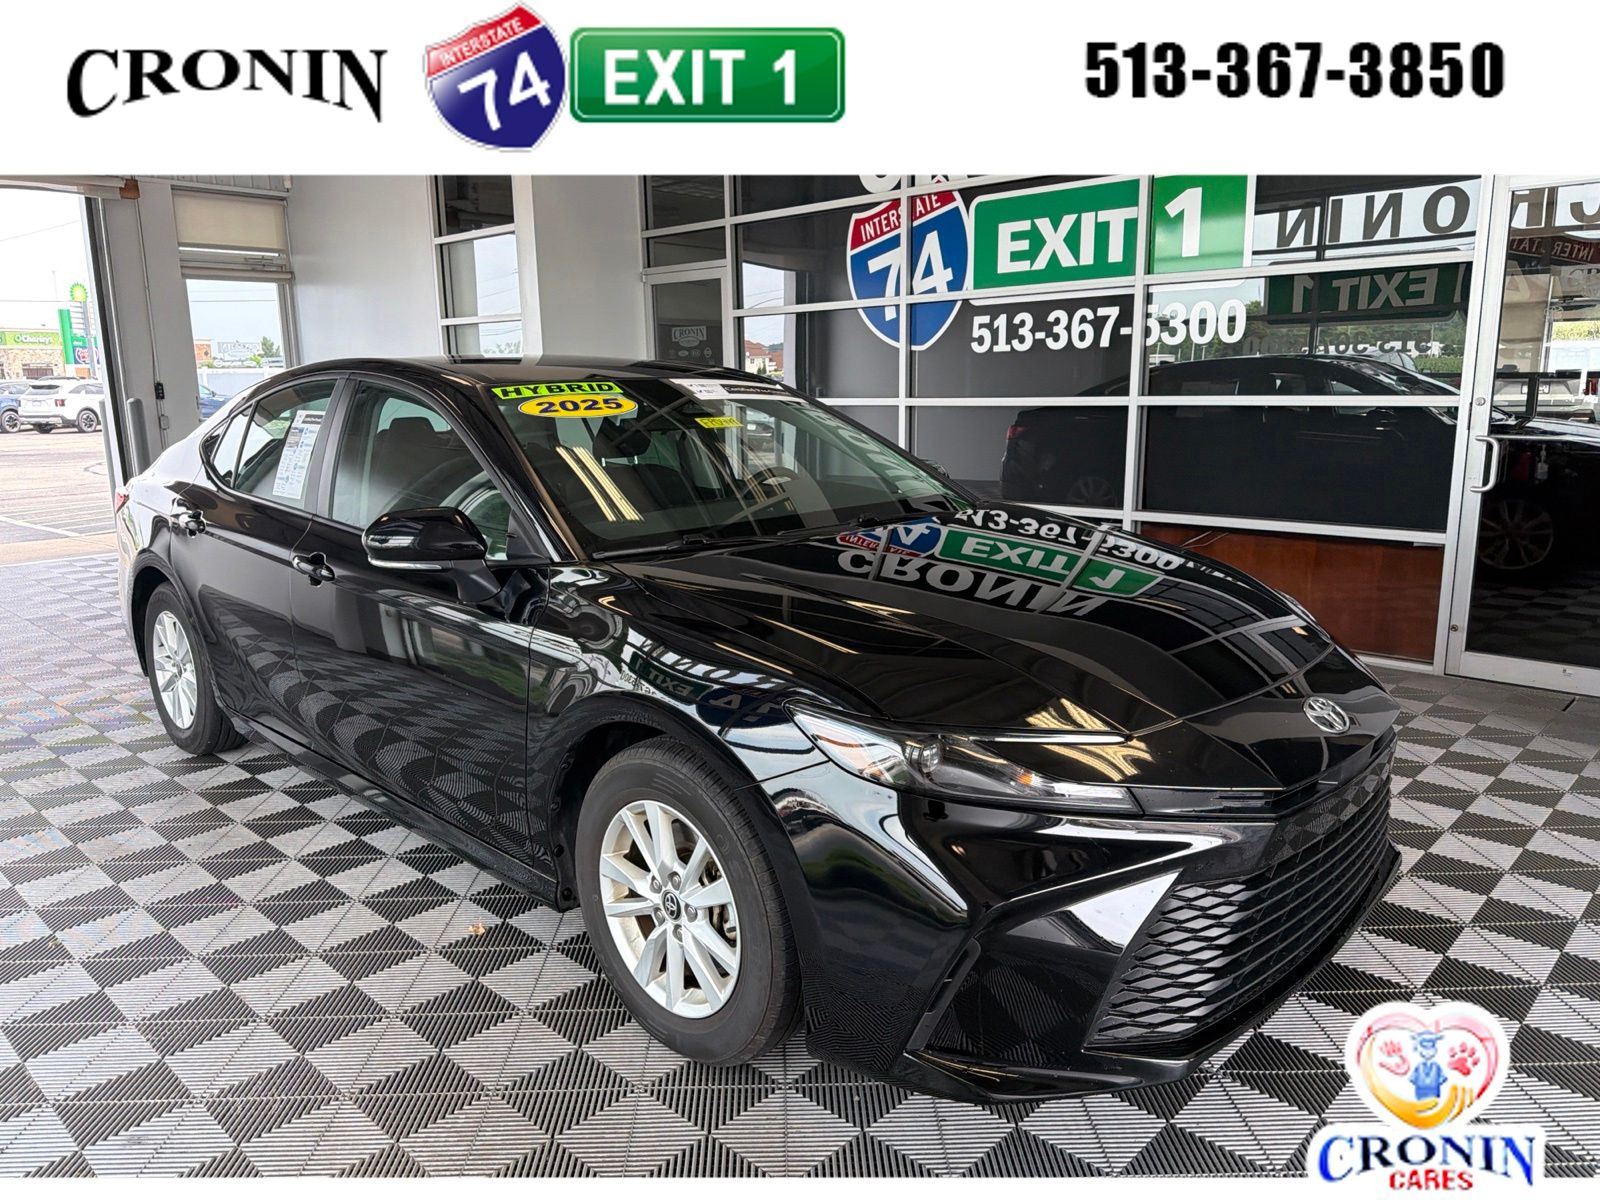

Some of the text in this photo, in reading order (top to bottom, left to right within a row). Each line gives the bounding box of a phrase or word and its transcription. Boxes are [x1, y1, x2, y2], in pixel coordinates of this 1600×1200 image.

[997, 187, 1203, 275] EXIT 1
[867, 231, 954, 321] 74
[500, 382, 614, 398] HYBRID
[535, 398, 623, 414] 2025
